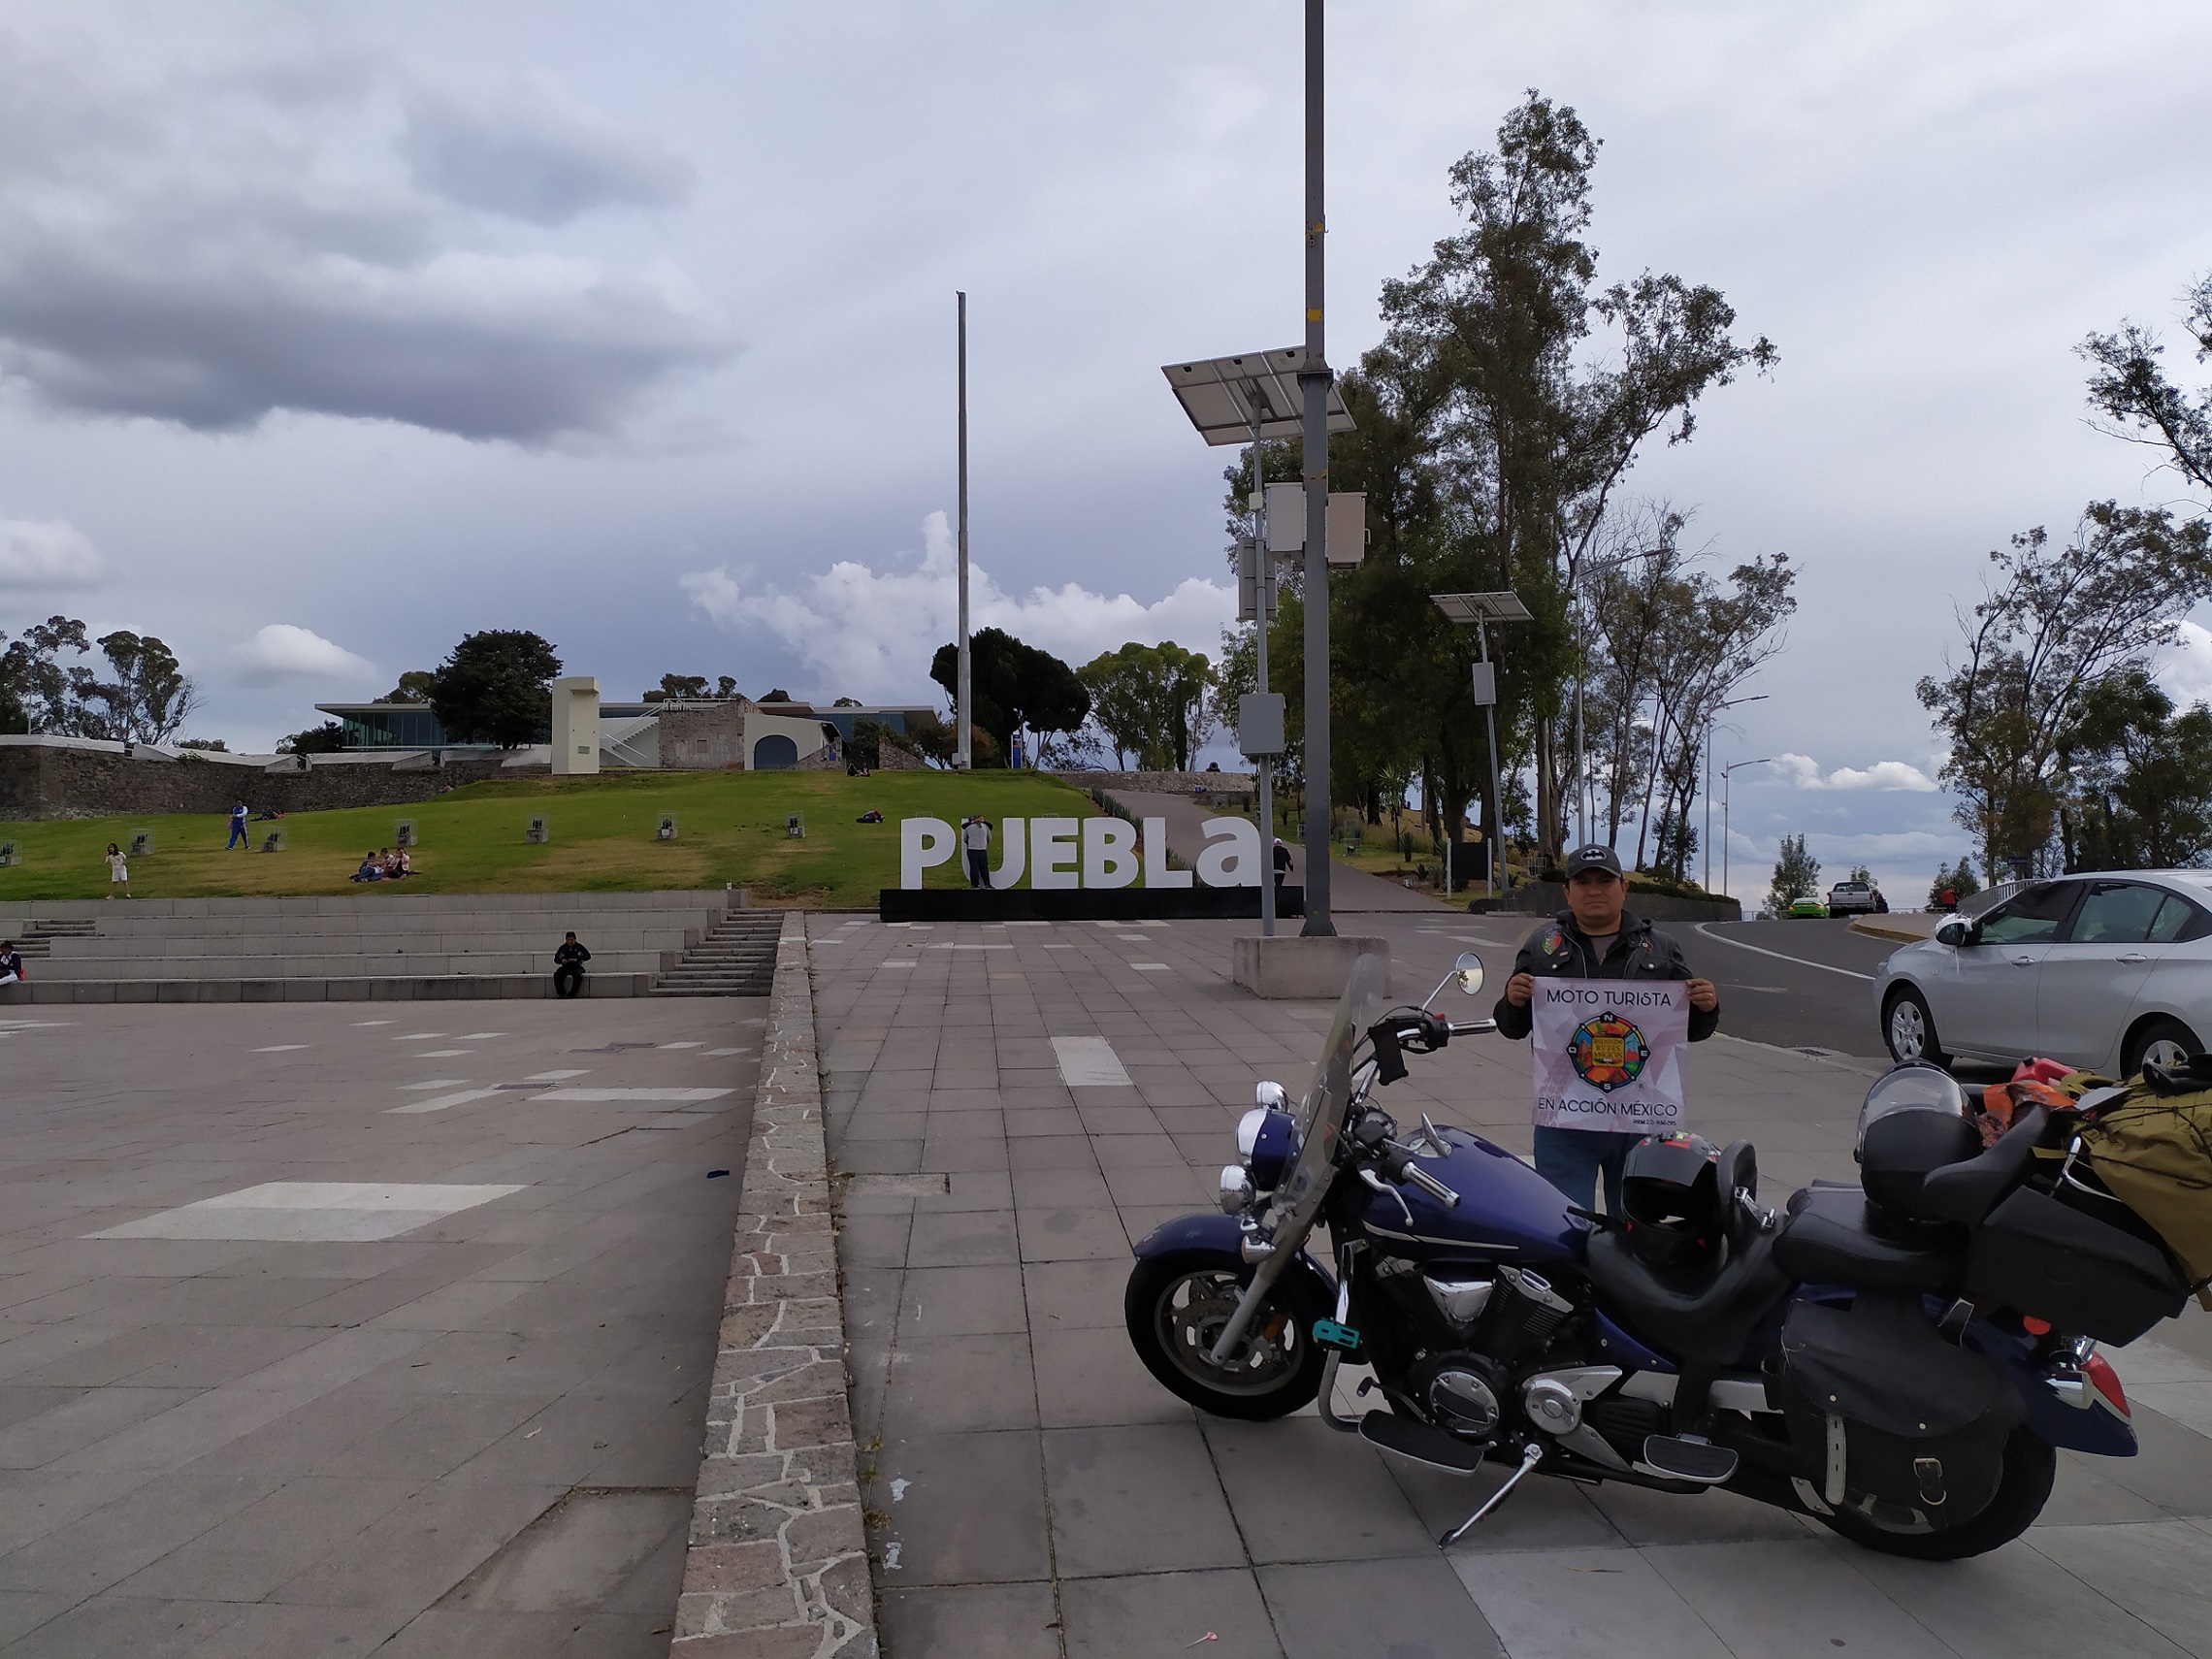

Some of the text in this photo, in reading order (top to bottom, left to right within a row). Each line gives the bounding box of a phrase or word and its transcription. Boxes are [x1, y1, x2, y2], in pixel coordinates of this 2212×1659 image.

[1546, 989, 1672, 1006] MOTO TURISTA
[1538, 1097, 1677, 1117] EN ACCIÓN MÉXICO
